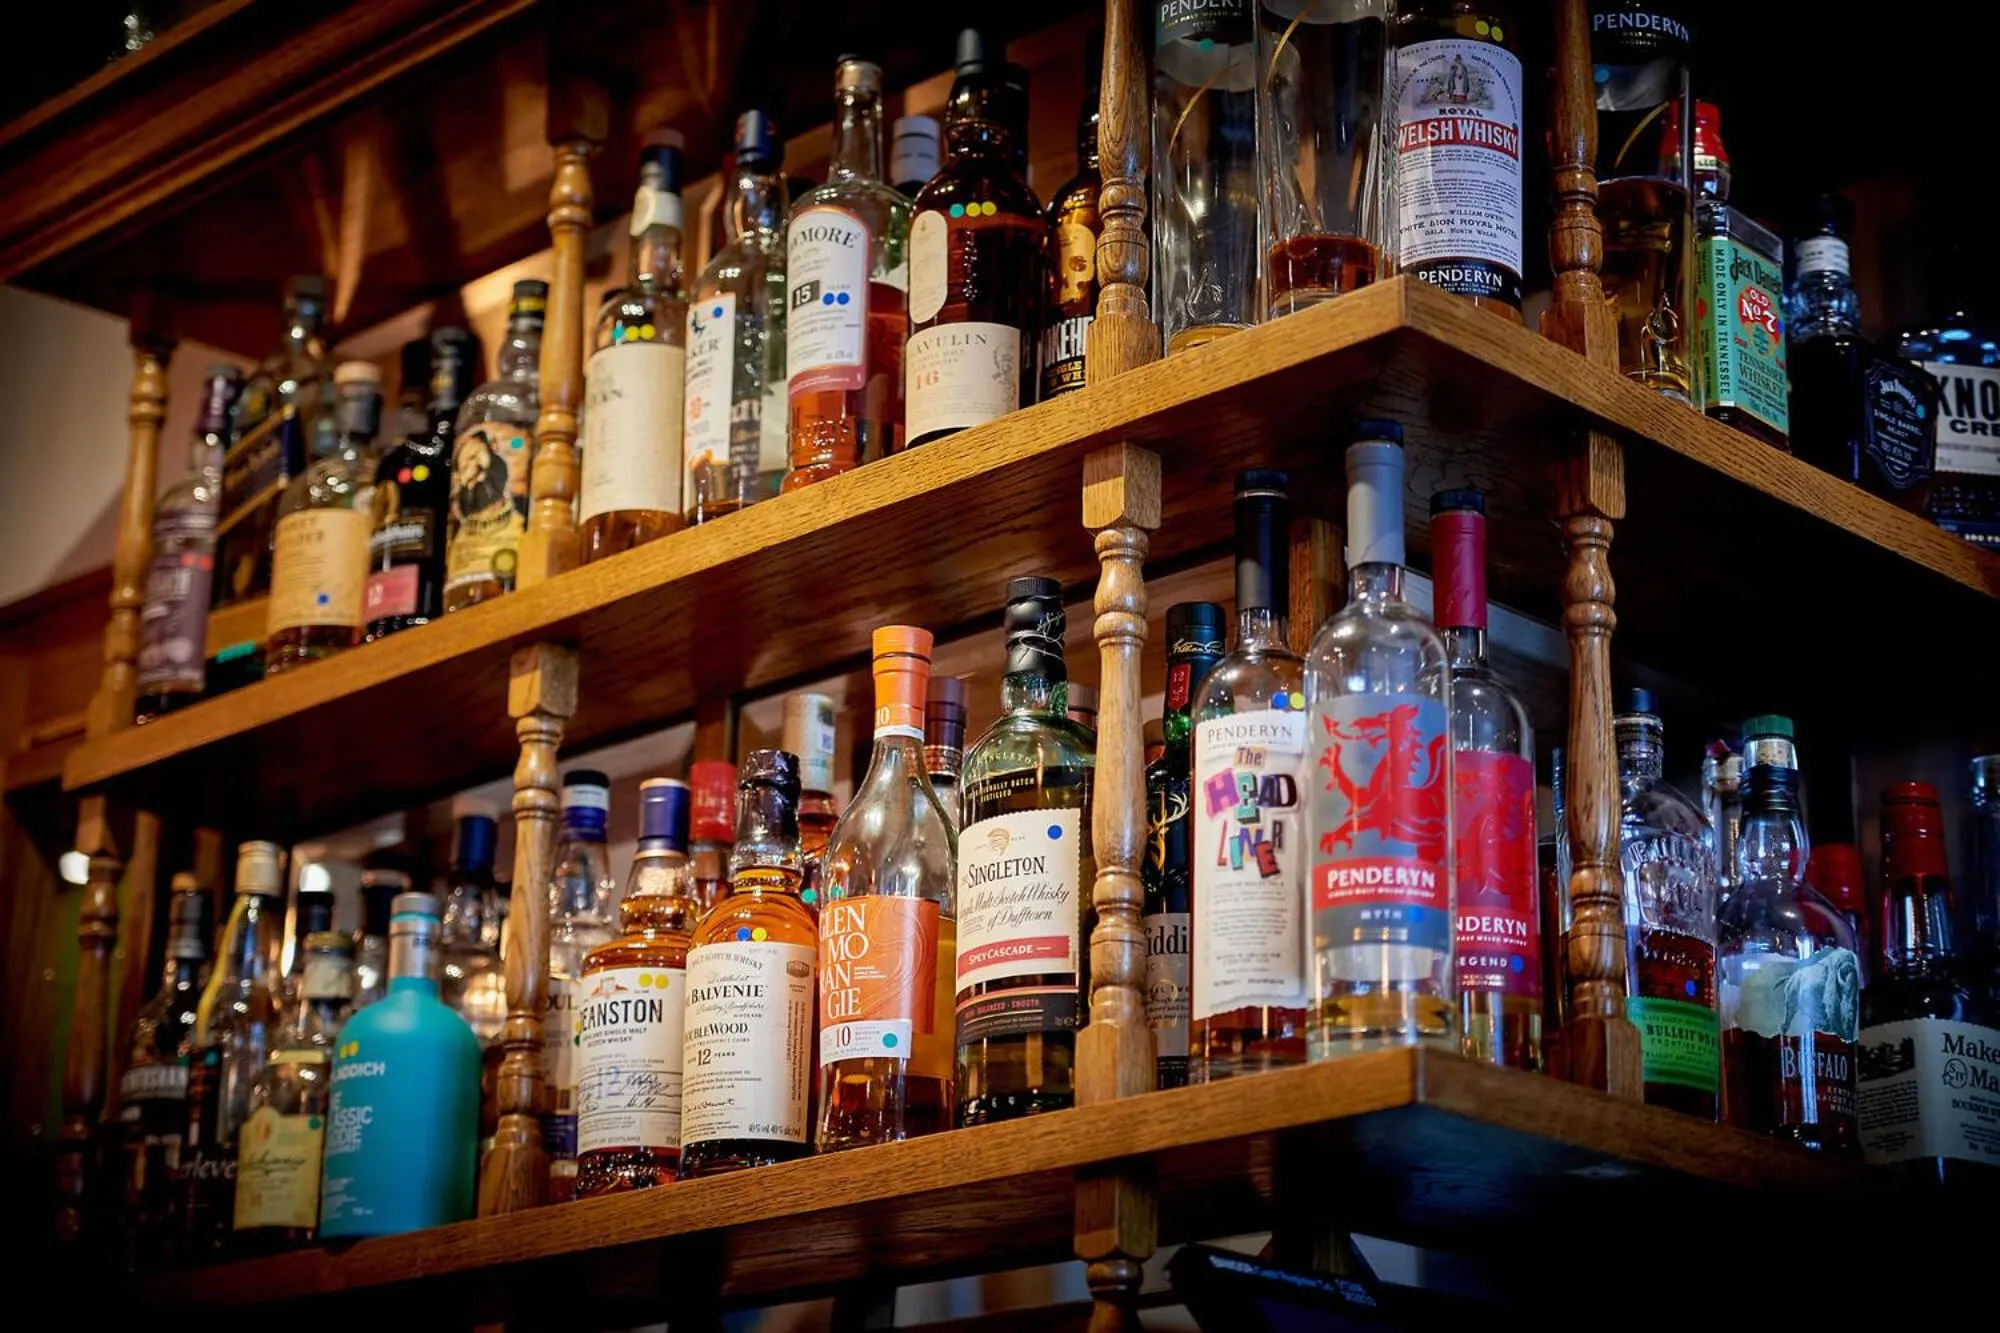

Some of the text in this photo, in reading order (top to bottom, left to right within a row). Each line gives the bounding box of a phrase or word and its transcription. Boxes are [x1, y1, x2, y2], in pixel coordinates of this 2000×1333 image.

[1593, 12, 1689, 43] PENDERYN
[1439, 107, 1484, 118] ROYAL
[1457, 119, 1518, 154] WHISKY
[1418, 268, 1503, 288] PENDERYN
[795, 284, 812, 306] 15
[1750, 289, 1769, 307] OLD
[1715, 248, 1731, 395] MADE ONLY IN TENNESSEE
[1762, 310, 1776, 333] 7
[1207, 723, 1293, 743] PENDERYN
[1237, 746, 1263, 767] The
[1011, 777, 1035, 788] BATCH
[1204, 768, 1298, 825] HEAD
[1217, 820, 1284, 879] LINER
[968, 855, 1045, 889] SINGLETON
[1327, 866, 1436, 889] PENDERYN
[1026, 882, 1070, 905] Whisky
[827, 932, 870, 964] MO
[691, 984, 764, 1005] BALVENIE
[827, 987, 862, 1019] GIE
[835, 1025, 852, 1048] 10
[697, 1048, 712, 1067] 12
[1941, 1032, 2000, 1065] Make
[1783, 1046, 1849, 1082] BFALO
